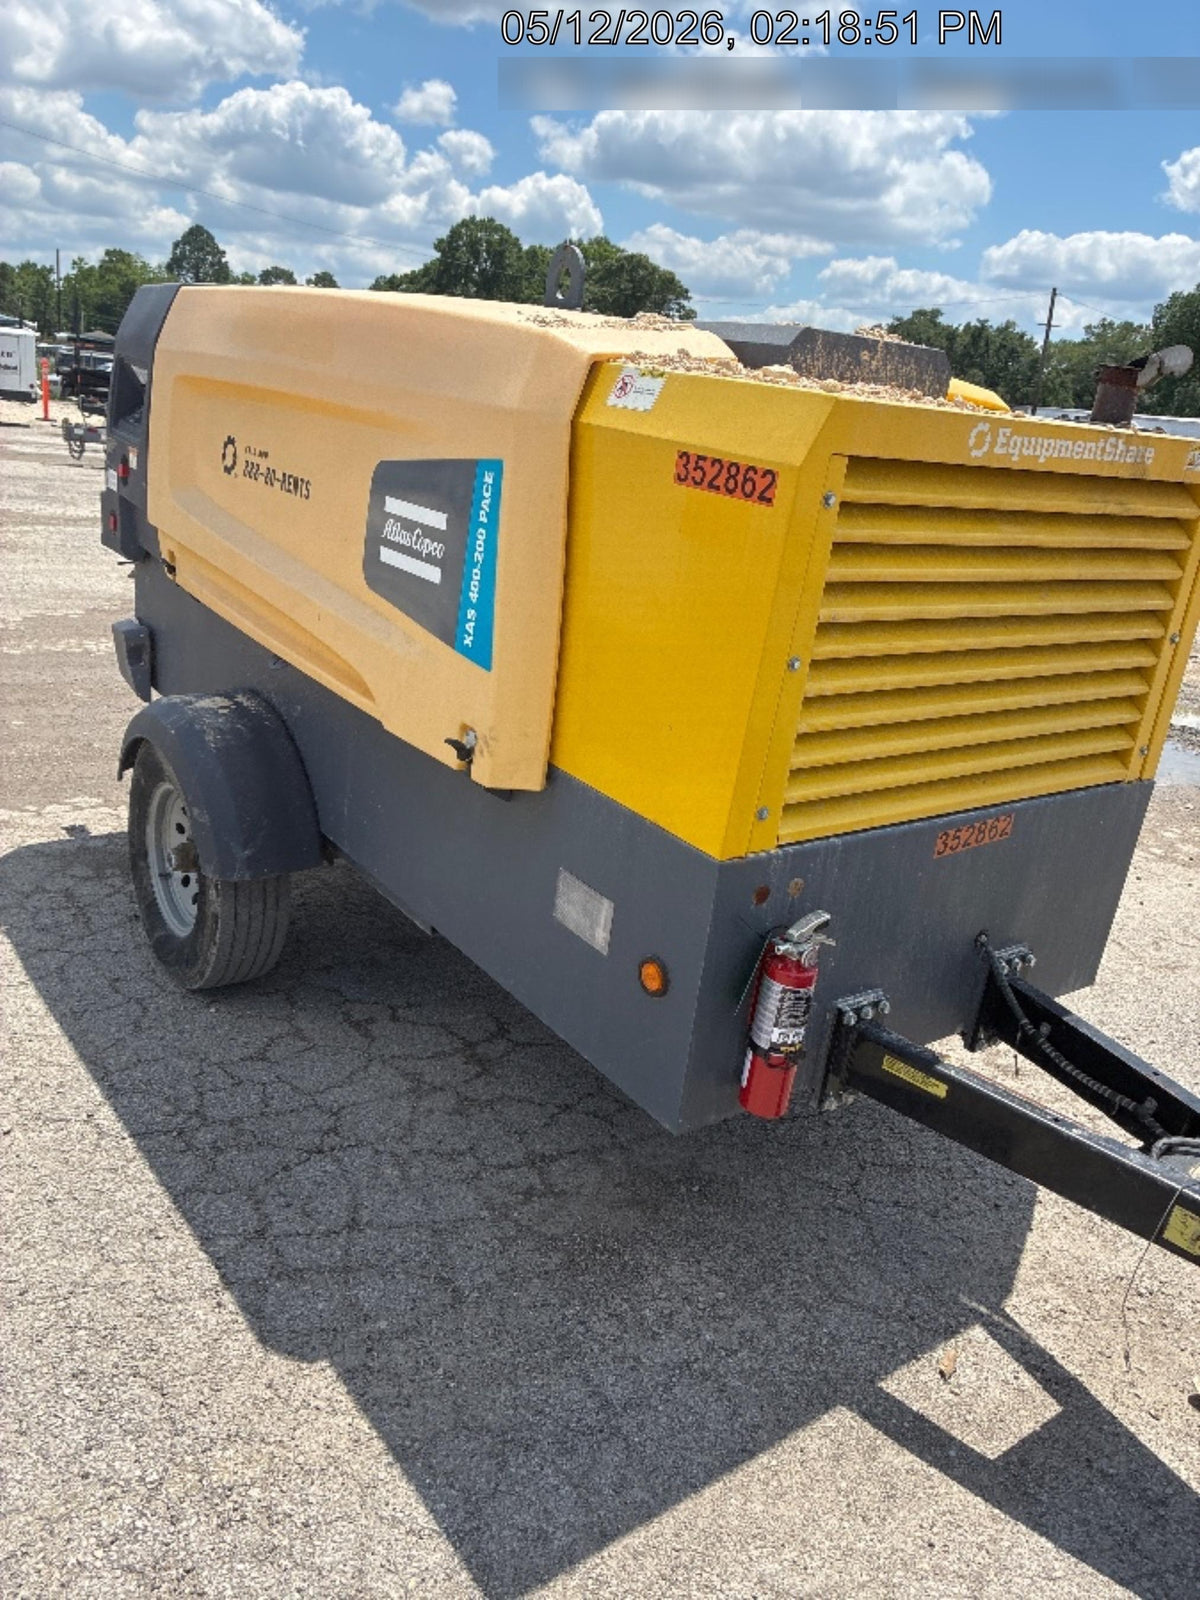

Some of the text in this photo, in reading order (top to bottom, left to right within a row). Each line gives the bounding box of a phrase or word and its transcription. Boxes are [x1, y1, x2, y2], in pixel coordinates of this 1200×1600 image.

[994, 427, 1155, 465] EquipmentShare
[676, 450, 777, 503] 352862
[464, 471, 495, 648] XAS 400-200 PACE
